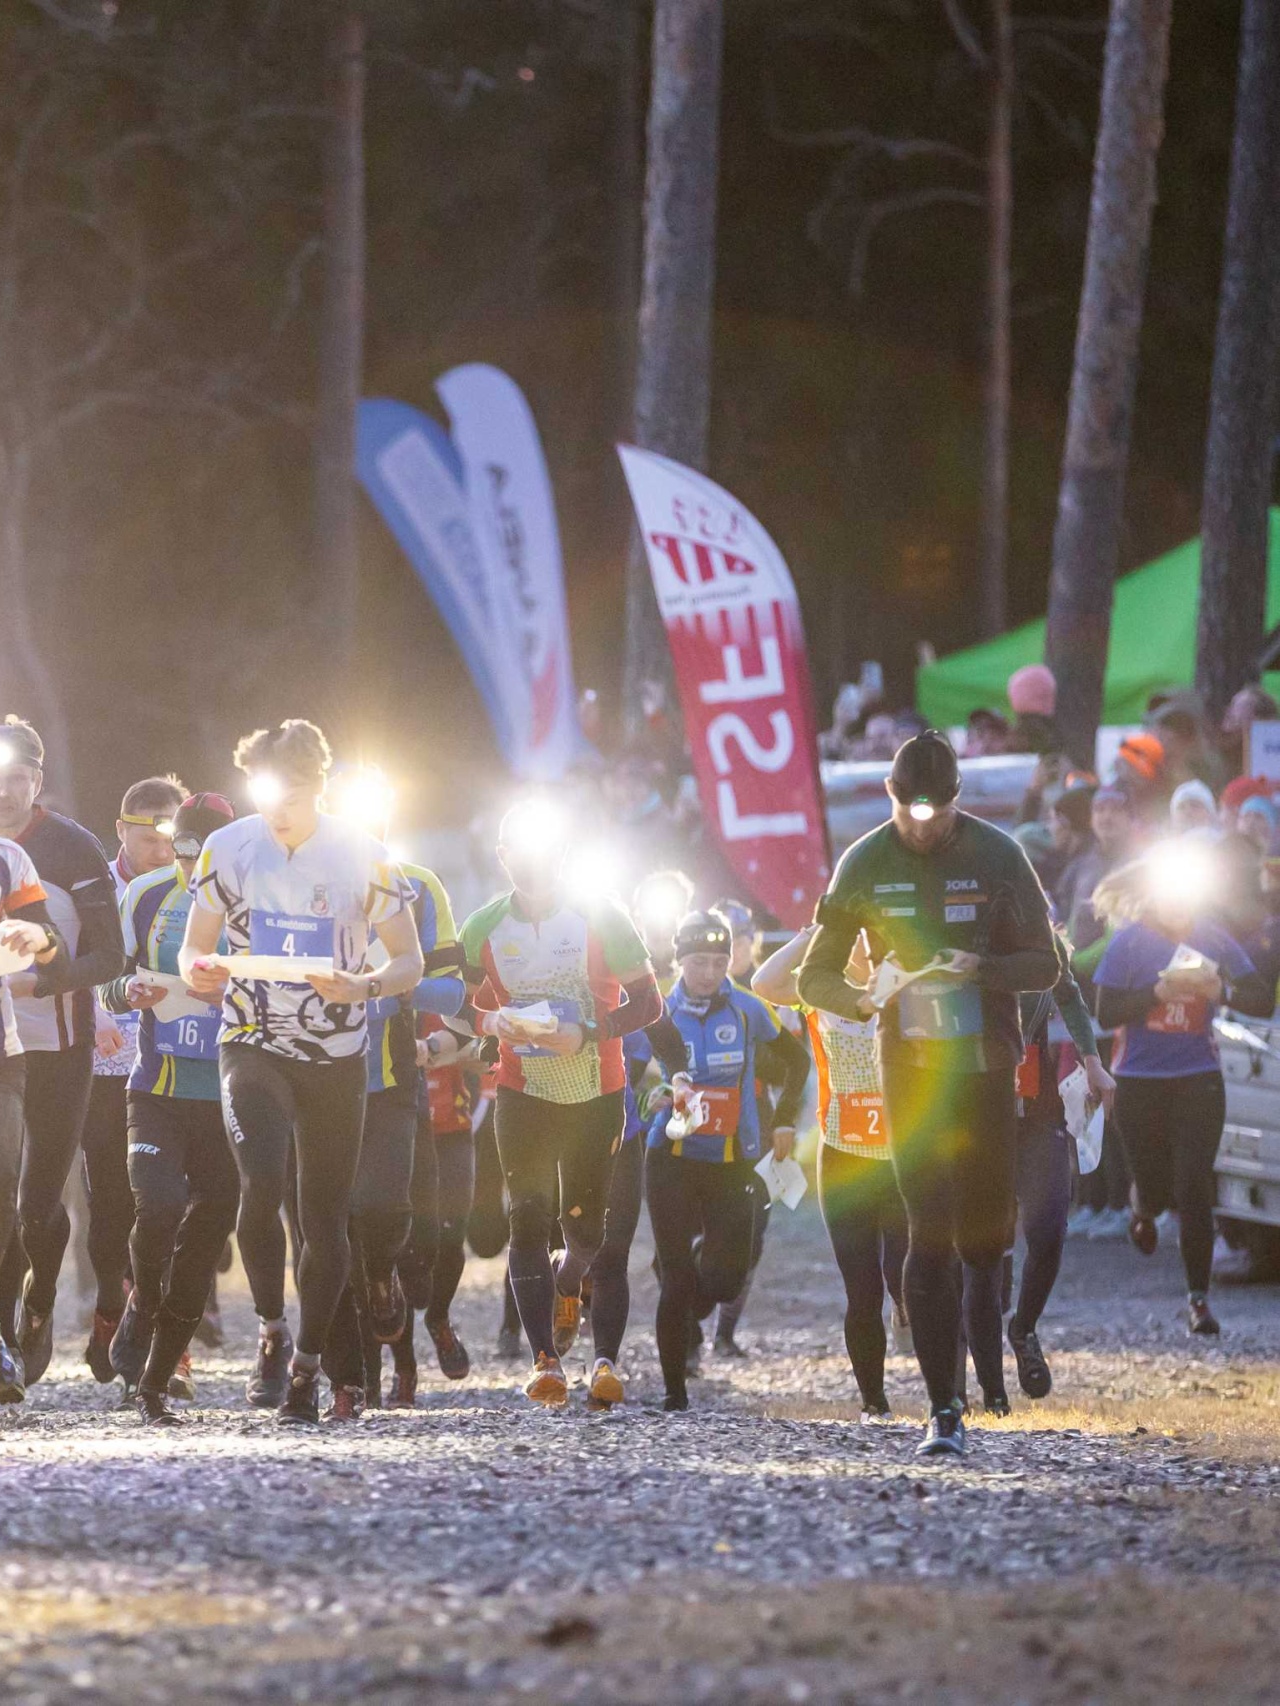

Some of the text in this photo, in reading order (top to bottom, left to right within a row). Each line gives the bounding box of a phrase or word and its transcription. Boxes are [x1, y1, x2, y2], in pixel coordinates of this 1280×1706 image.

[945, 880, 978, 890] JOKA
[281, 933, 295, 957] 4
[930, 999, 941, 1028] 1
[177, 1019, 204, 1054] 16 1
[714, 1117, 722, 1132] 2
[866, 1109, 879, 1135] 2
